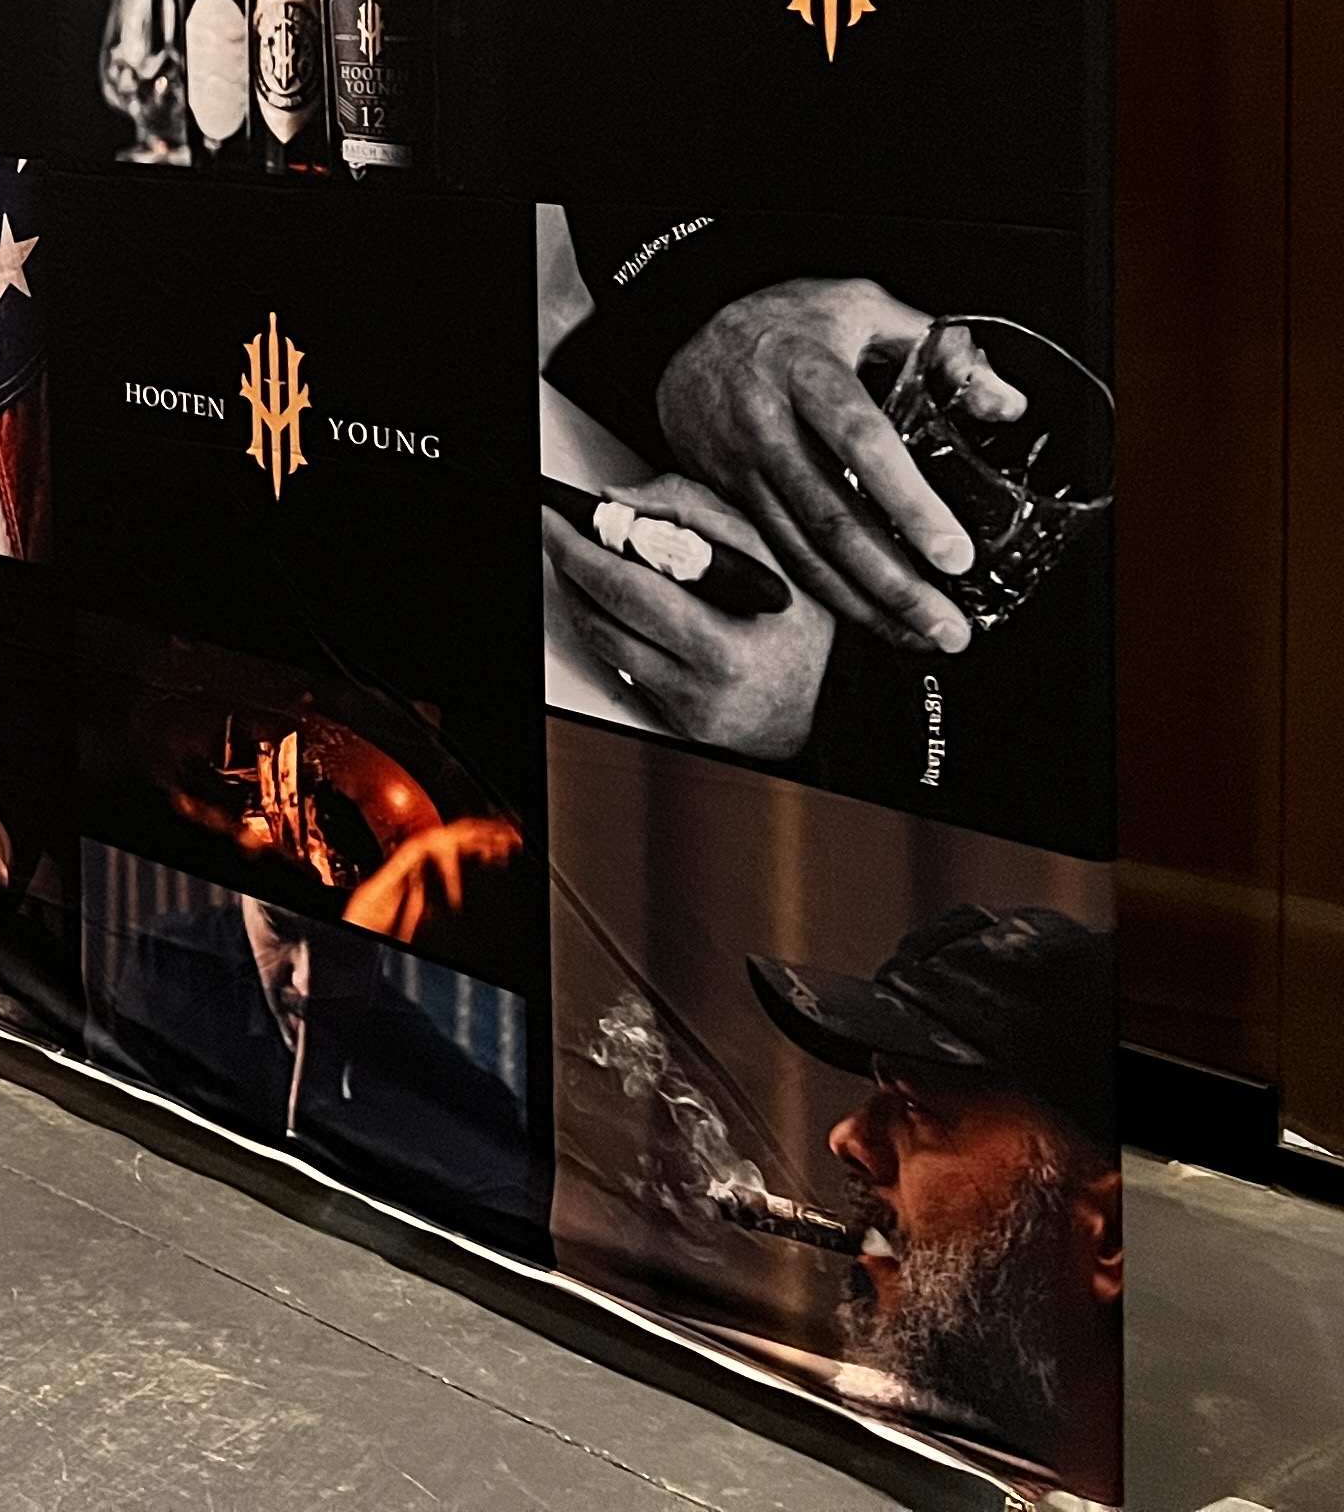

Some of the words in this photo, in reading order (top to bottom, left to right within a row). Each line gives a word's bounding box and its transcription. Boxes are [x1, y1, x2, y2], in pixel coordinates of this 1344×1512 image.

[361, 106, 385, 128] 12
[613, 234, 670, 285] Whiskey
[125, 382, 225, 420] HOOTEN
[328, 417, 440, 459] YOUNG
[923, 675, 943, 736] Cigar
